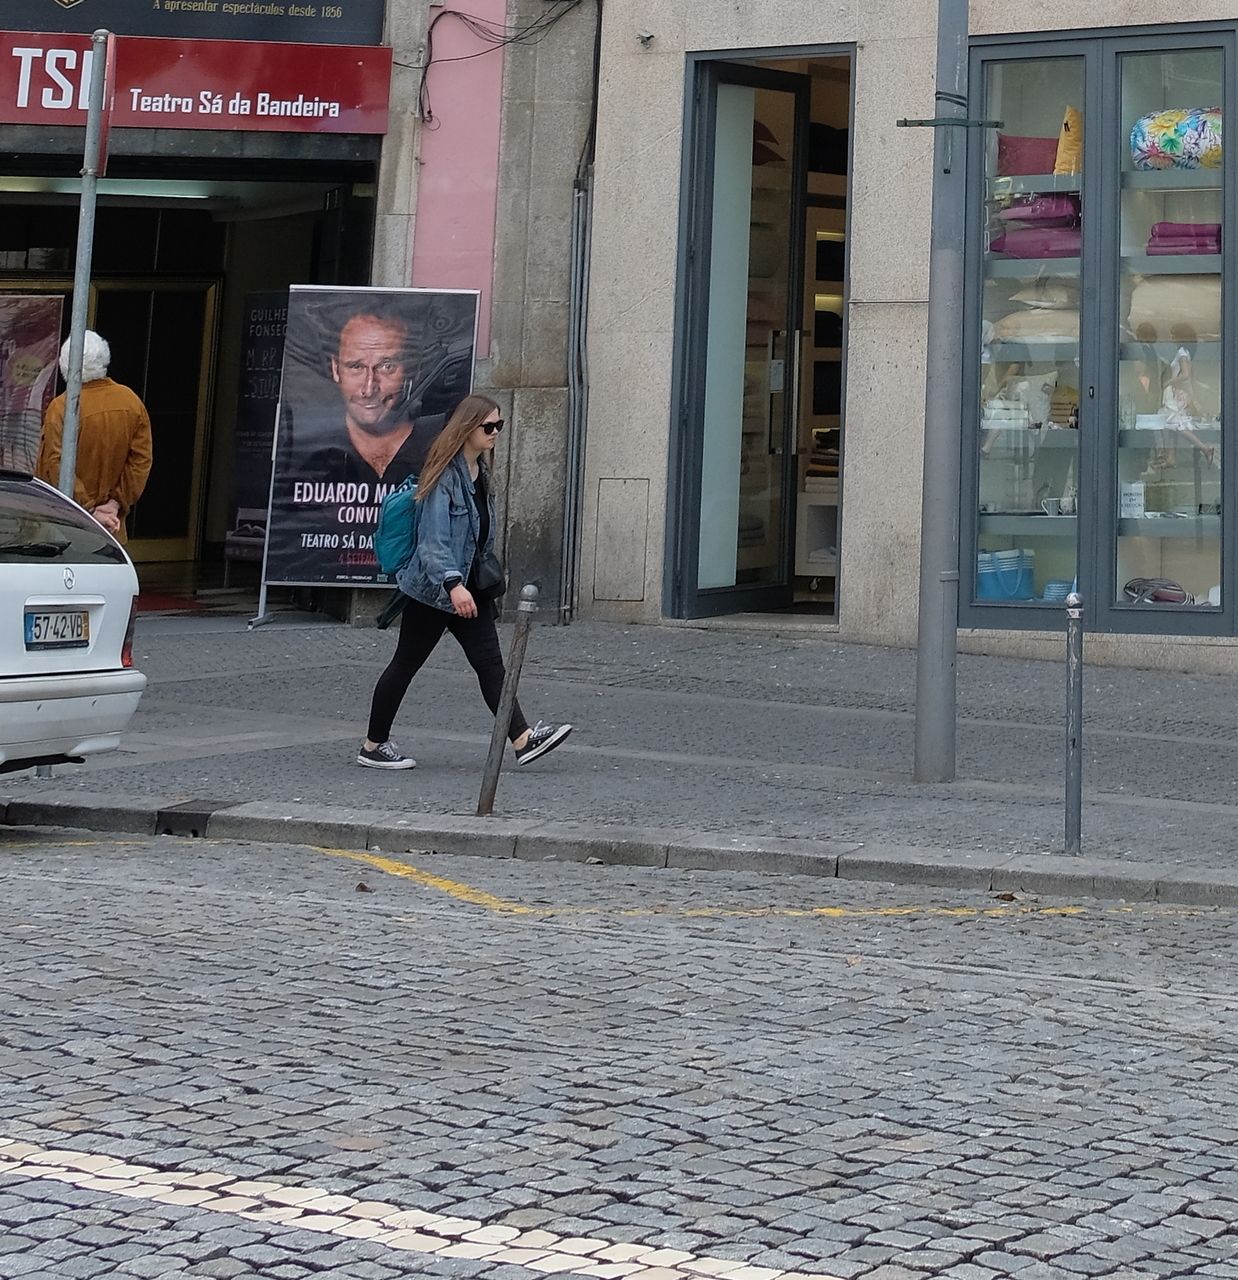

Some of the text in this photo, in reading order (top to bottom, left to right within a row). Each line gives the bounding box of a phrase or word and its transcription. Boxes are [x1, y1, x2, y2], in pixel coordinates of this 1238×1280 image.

[164, 0, 219, 13] apresentar
[222, 2, 285, 16] espectáculos
[288, 4, 316, 17] desde
[321, 6, 342, 18] 1856
[130, 88, 340, 118] Teatro Sá da Bandeira
[293, 482, 369, 504] EDUARDO
[301, 531, 374, 549] TEATRO SÁ DA
